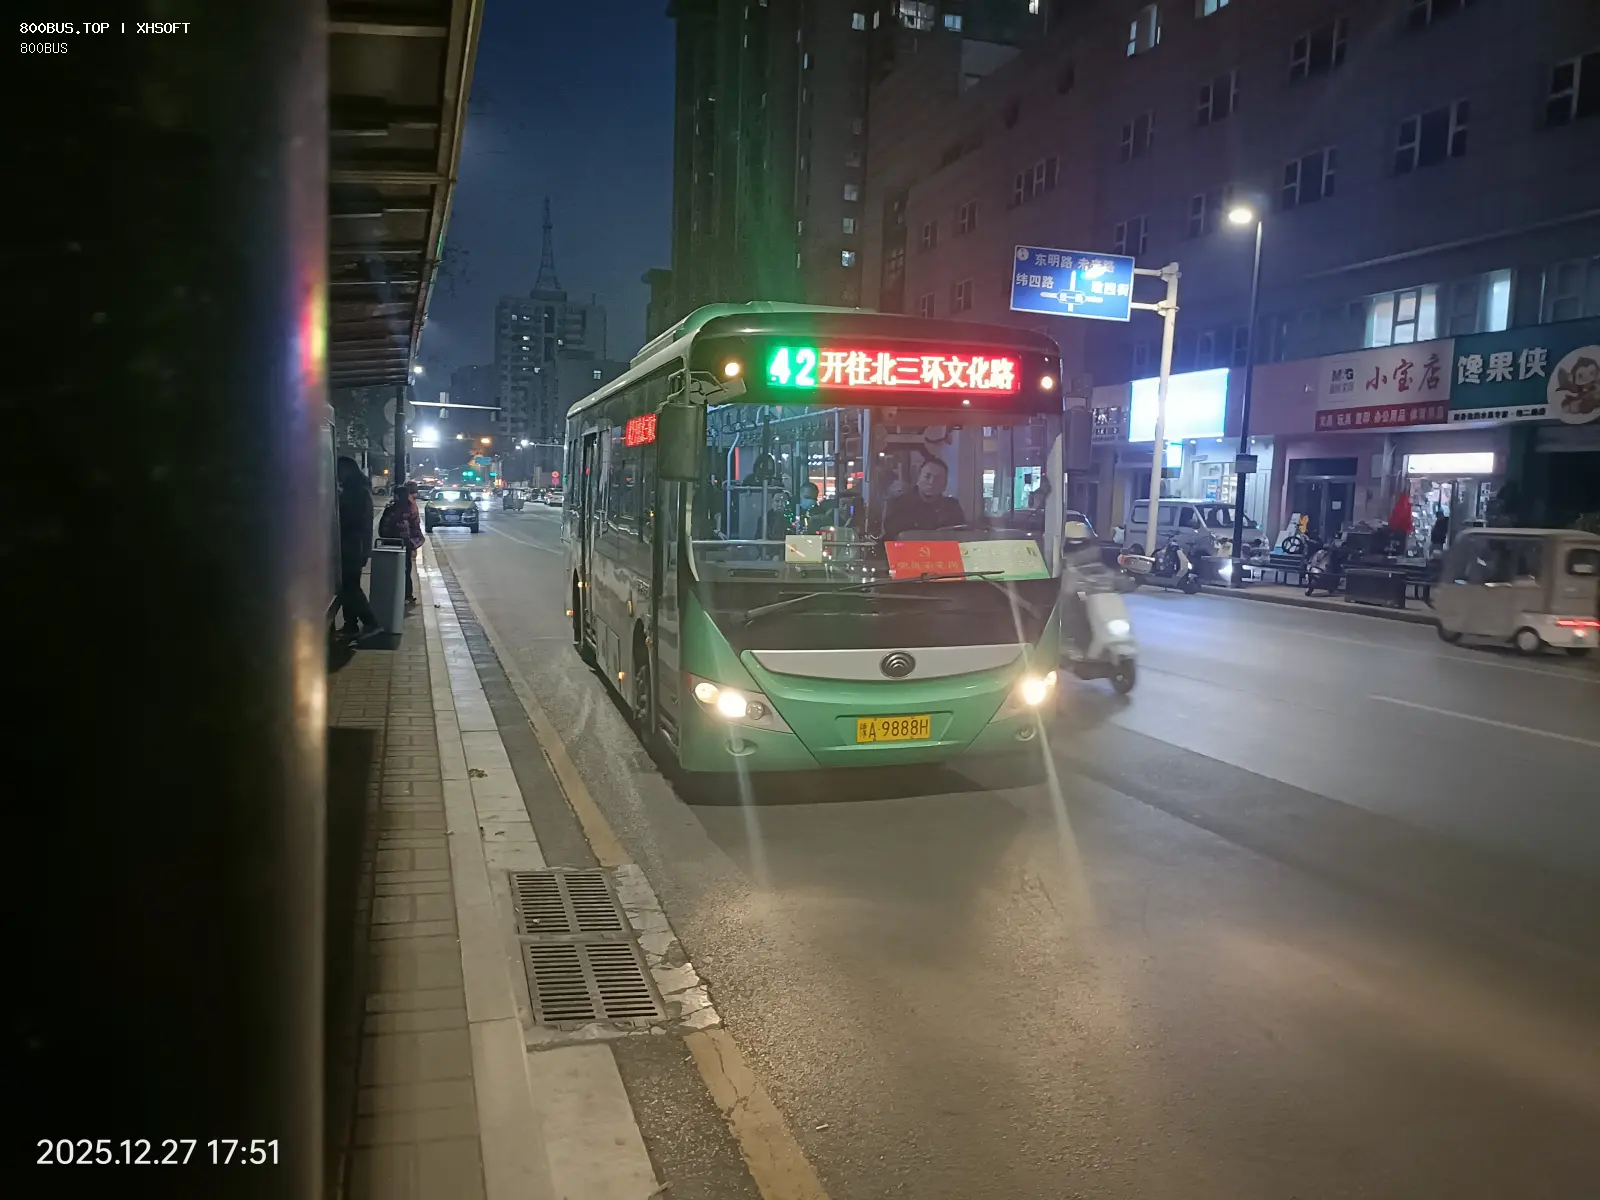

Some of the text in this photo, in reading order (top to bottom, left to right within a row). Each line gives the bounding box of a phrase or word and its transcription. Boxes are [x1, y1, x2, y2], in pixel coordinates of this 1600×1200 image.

[1034, 253, 1073, 269] 东明路
[1015, 272, 1054, 289] 纬四路
[769, 347, 1015, 390] 42 开往北三环文化路
[1365, 353, 1441, 392] 小宝店
[1457, 347, 1547, 385] 馋果侠
